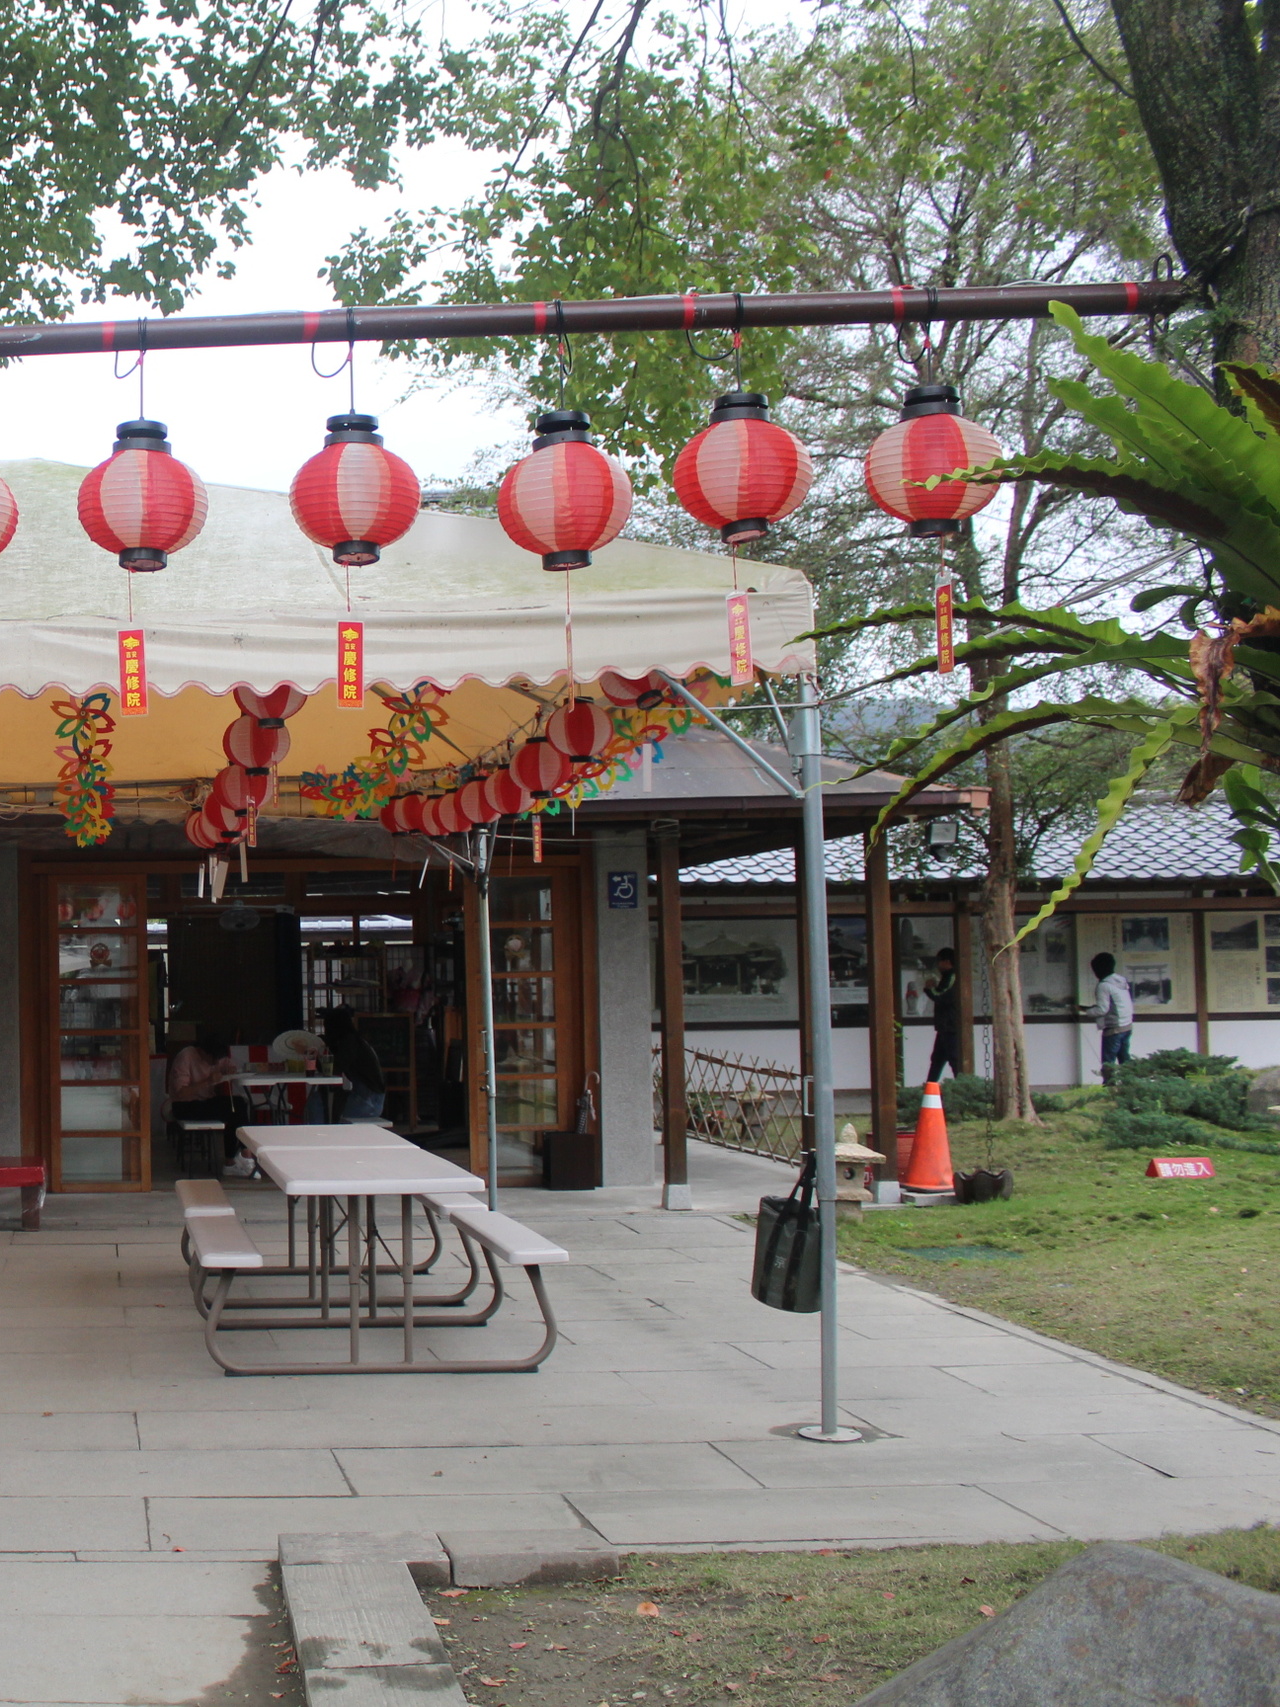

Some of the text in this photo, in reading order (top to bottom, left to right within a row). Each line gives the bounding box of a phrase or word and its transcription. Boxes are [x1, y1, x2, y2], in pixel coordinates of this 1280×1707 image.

[733, 625, 749, 675] 慶修院
[125, 659, 141, 708] 慶修院
[343, 651, 358, 700] 慶修院
[1158, 1162, 1212, 1177] 請勿進入
